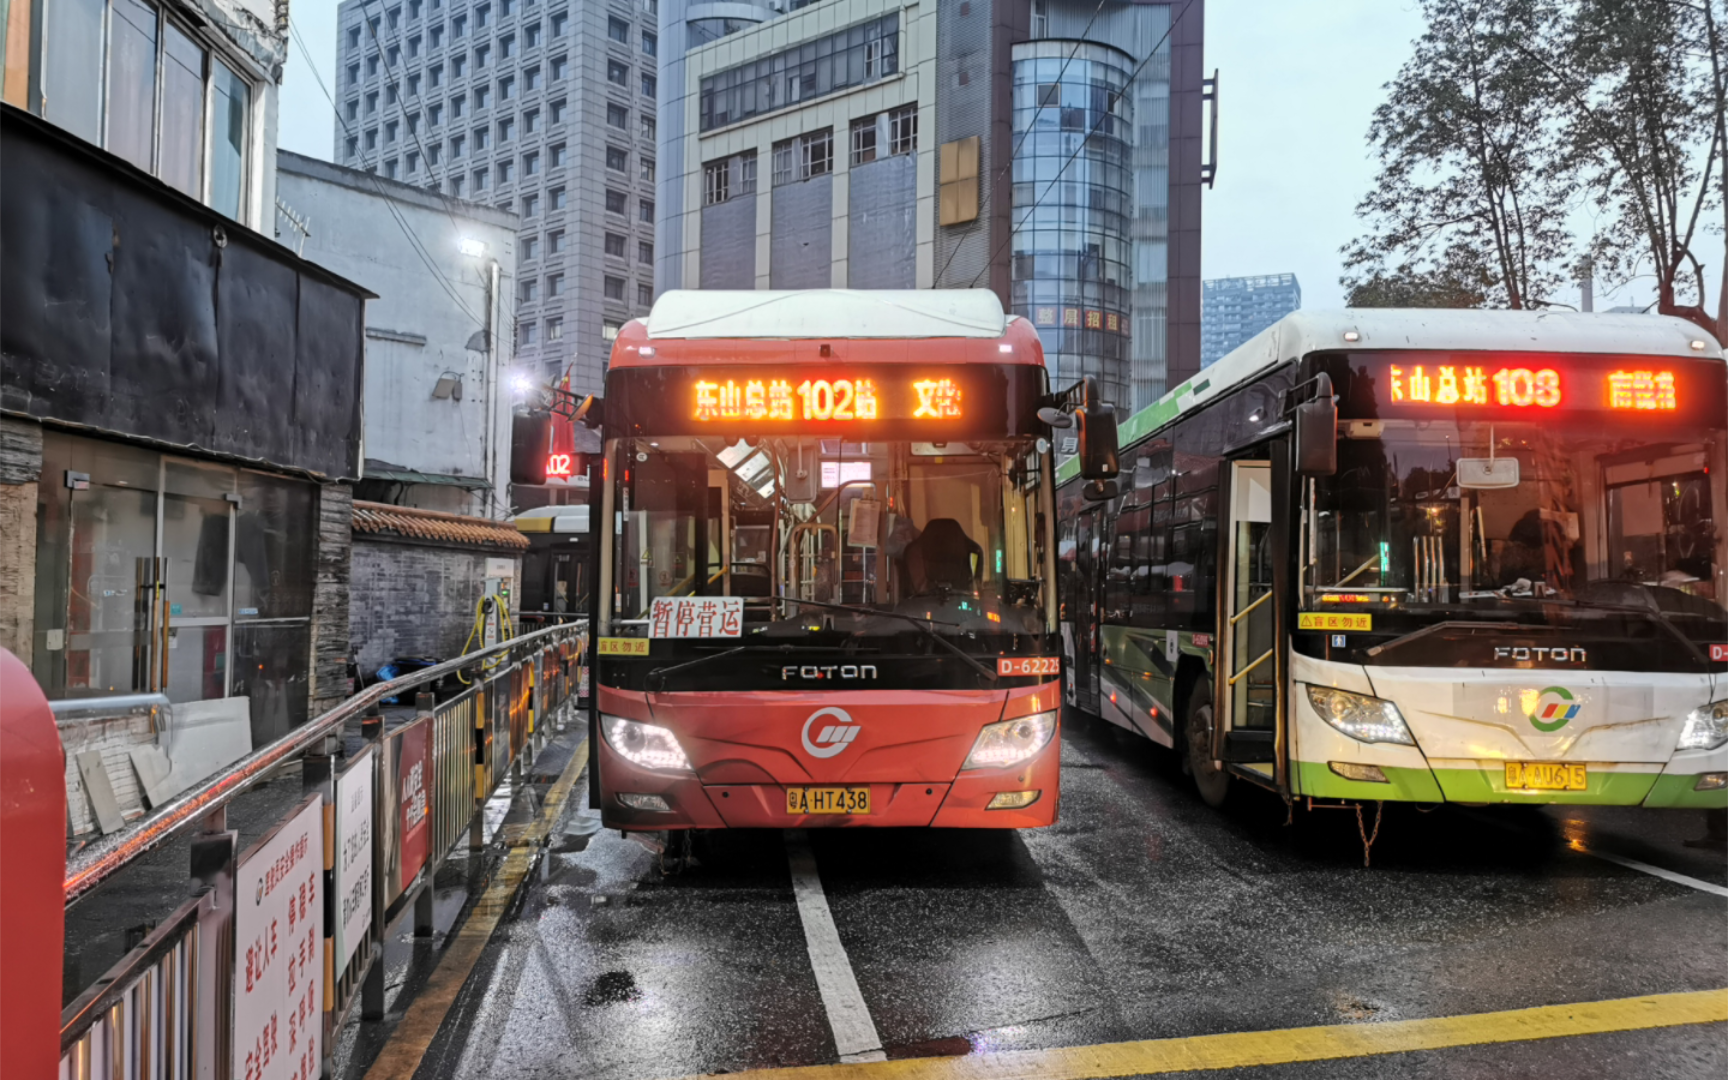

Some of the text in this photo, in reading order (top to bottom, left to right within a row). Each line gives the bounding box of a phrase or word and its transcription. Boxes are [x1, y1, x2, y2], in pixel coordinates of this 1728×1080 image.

[653, 600, 741, 638] 暂停营运
[1314, 616, 1367, 628] 盲区勿近
[1494, 647, 1586, 662] FOTON
[782, 665, 877, 680] FOTON
